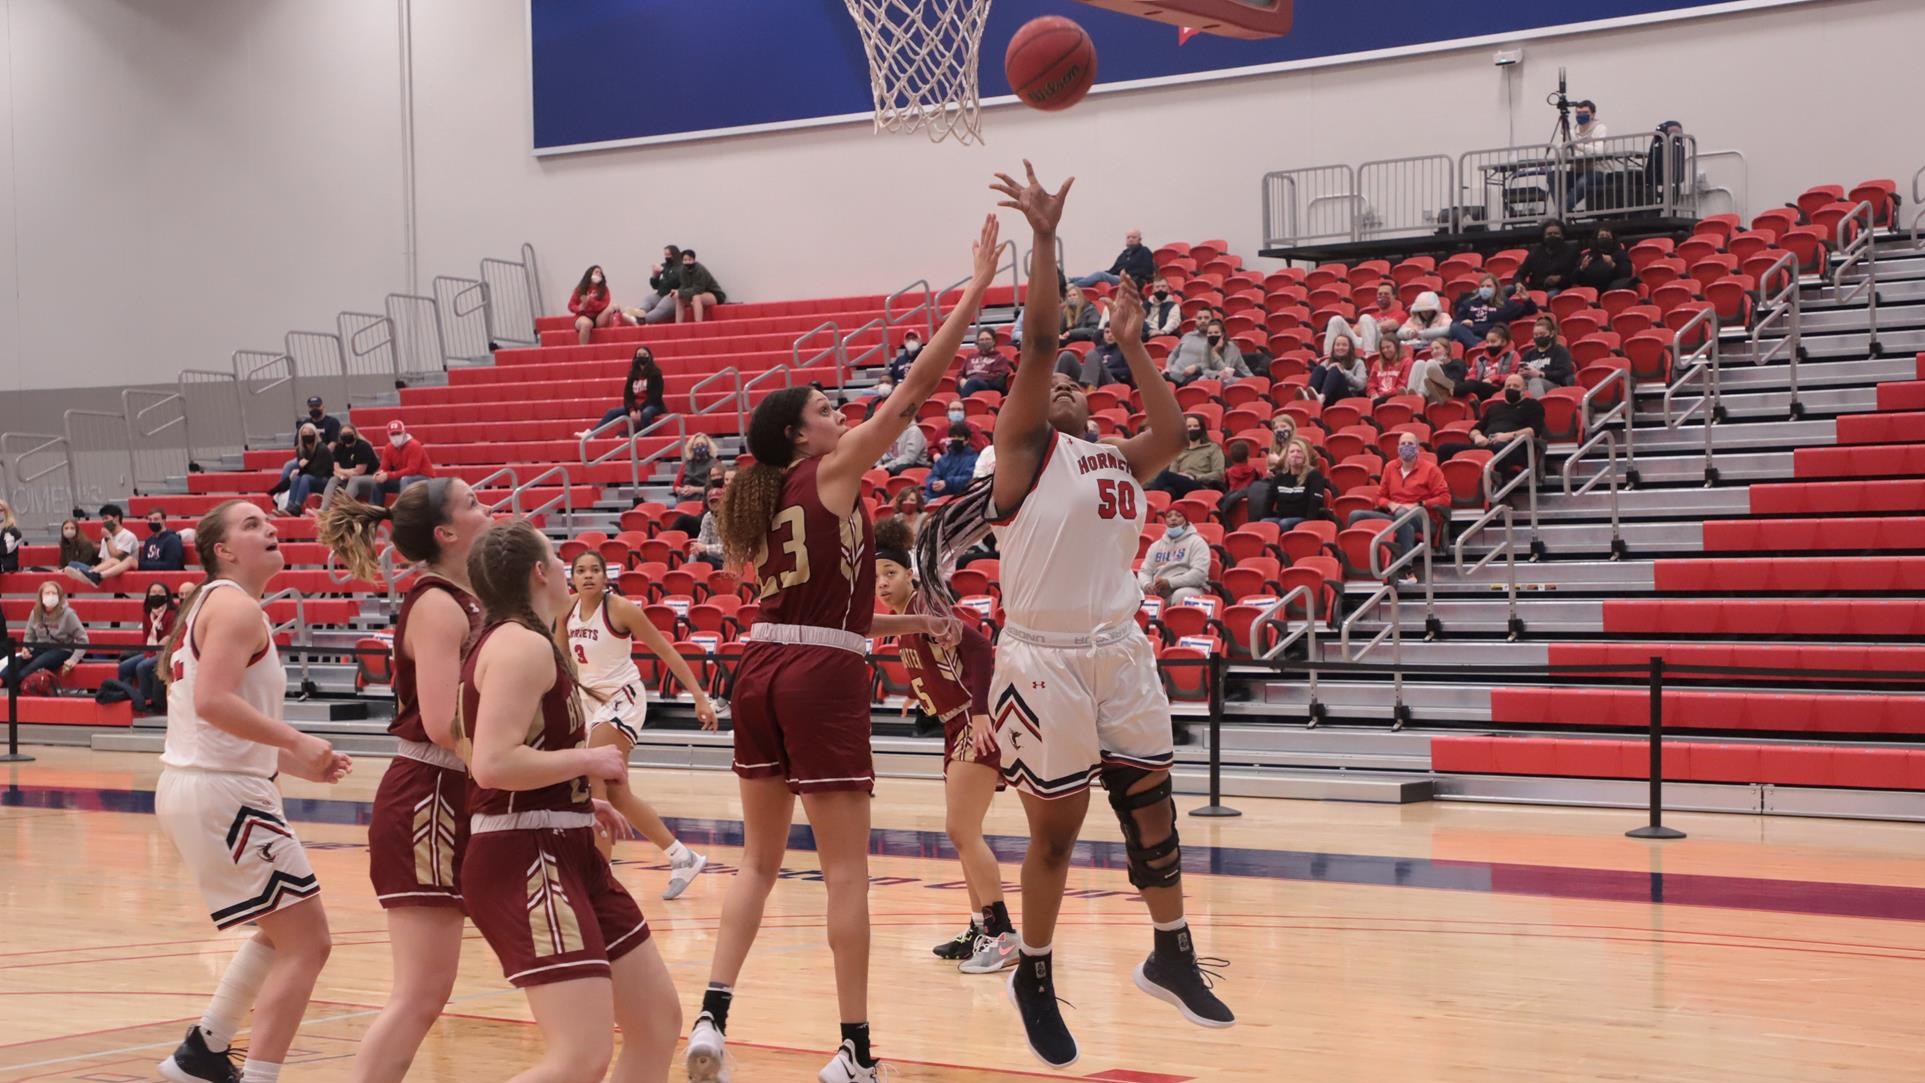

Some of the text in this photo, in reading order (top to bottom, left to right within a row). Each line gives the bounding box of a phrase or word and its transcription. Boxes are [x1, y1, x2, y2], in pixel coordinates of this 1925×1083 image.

[1027, 63, 1080, 102] Wilson
[0, 485, 104, 515] OMEN'S
[1096, 478, 1137, 519] 50
[574, 644, 588, 664] 3
[911, 676, 937, 717] 5
